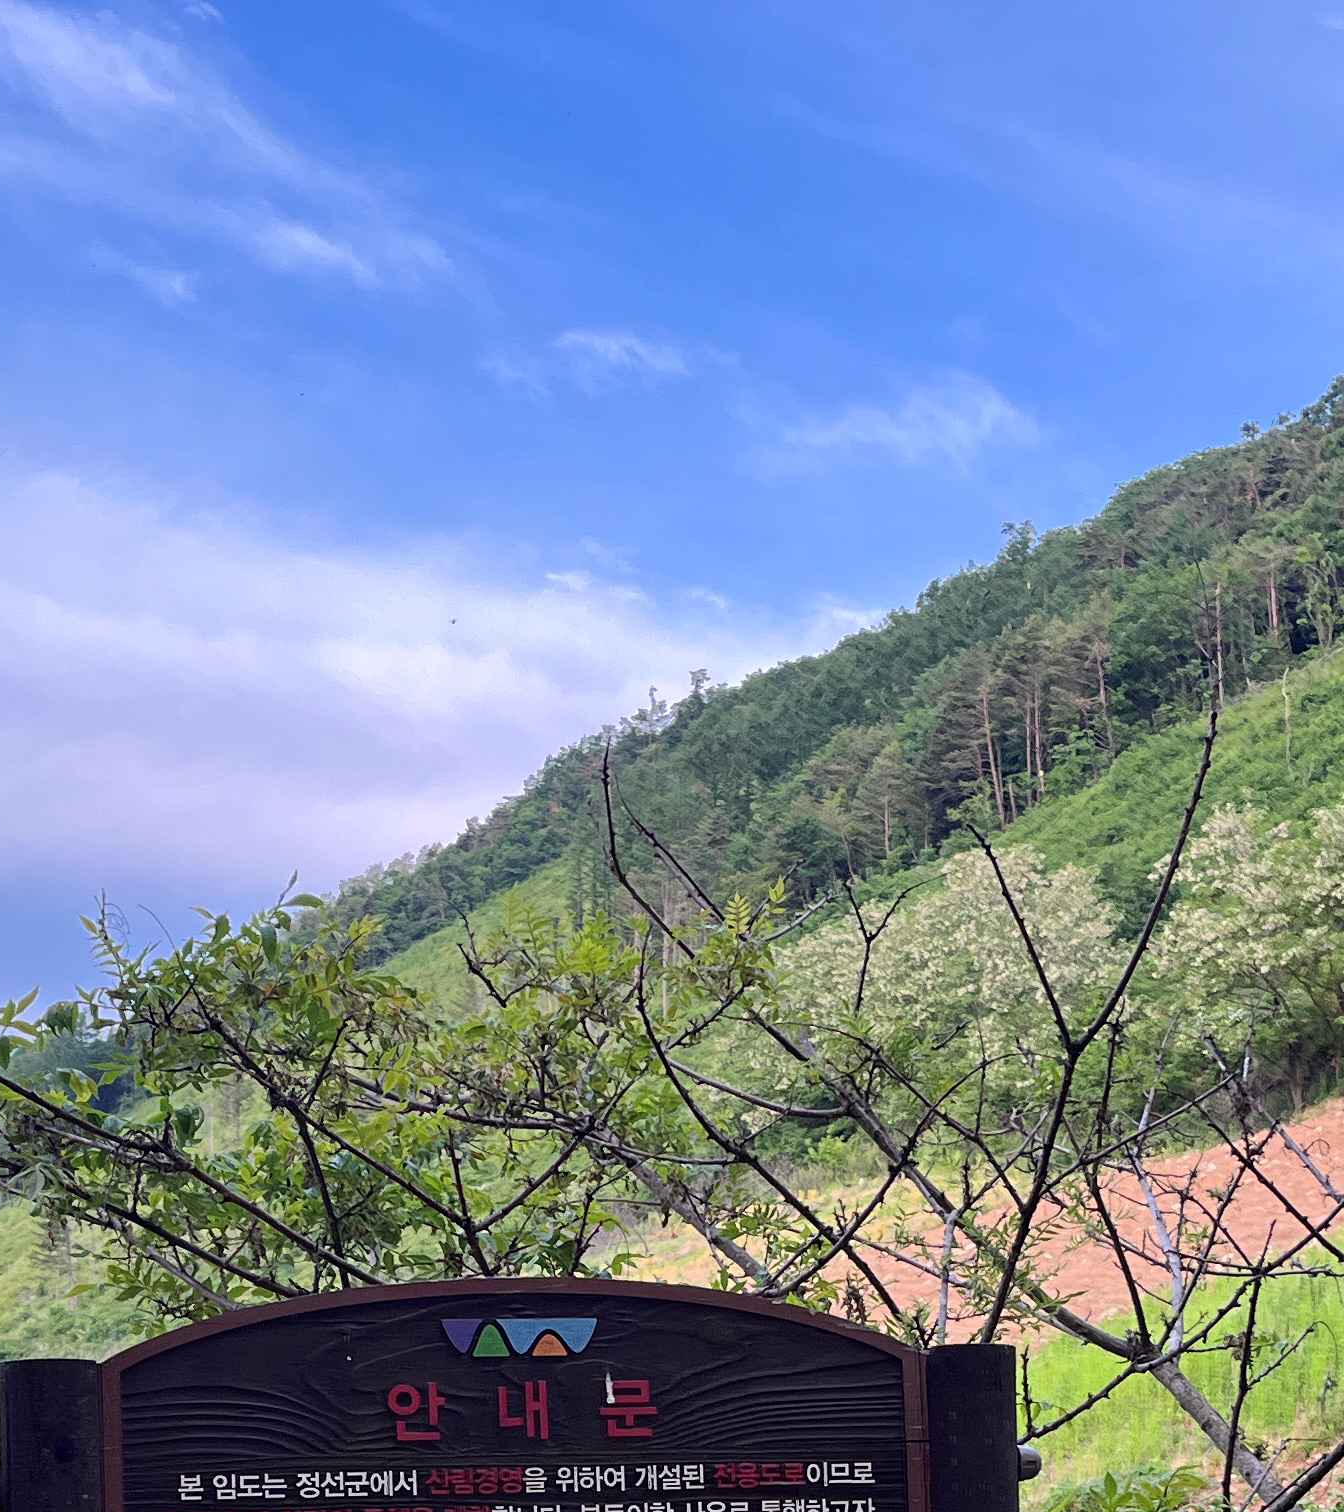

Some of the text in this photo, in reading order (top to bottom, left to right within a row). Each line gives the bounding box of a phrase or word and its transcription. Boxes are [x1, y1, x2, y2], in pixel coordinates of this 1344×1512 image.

[178, 1474, 204, 1500] 본
[213, 1474, 288, 1499] 임도는
[296, 1469, 418, 1499] 정선군에서
[555, 1466, 626, 1492] 위하여
[635, 1465, 705, 1490] 개설된
[714, 1461, 876, 1489] 전용도로이므로
